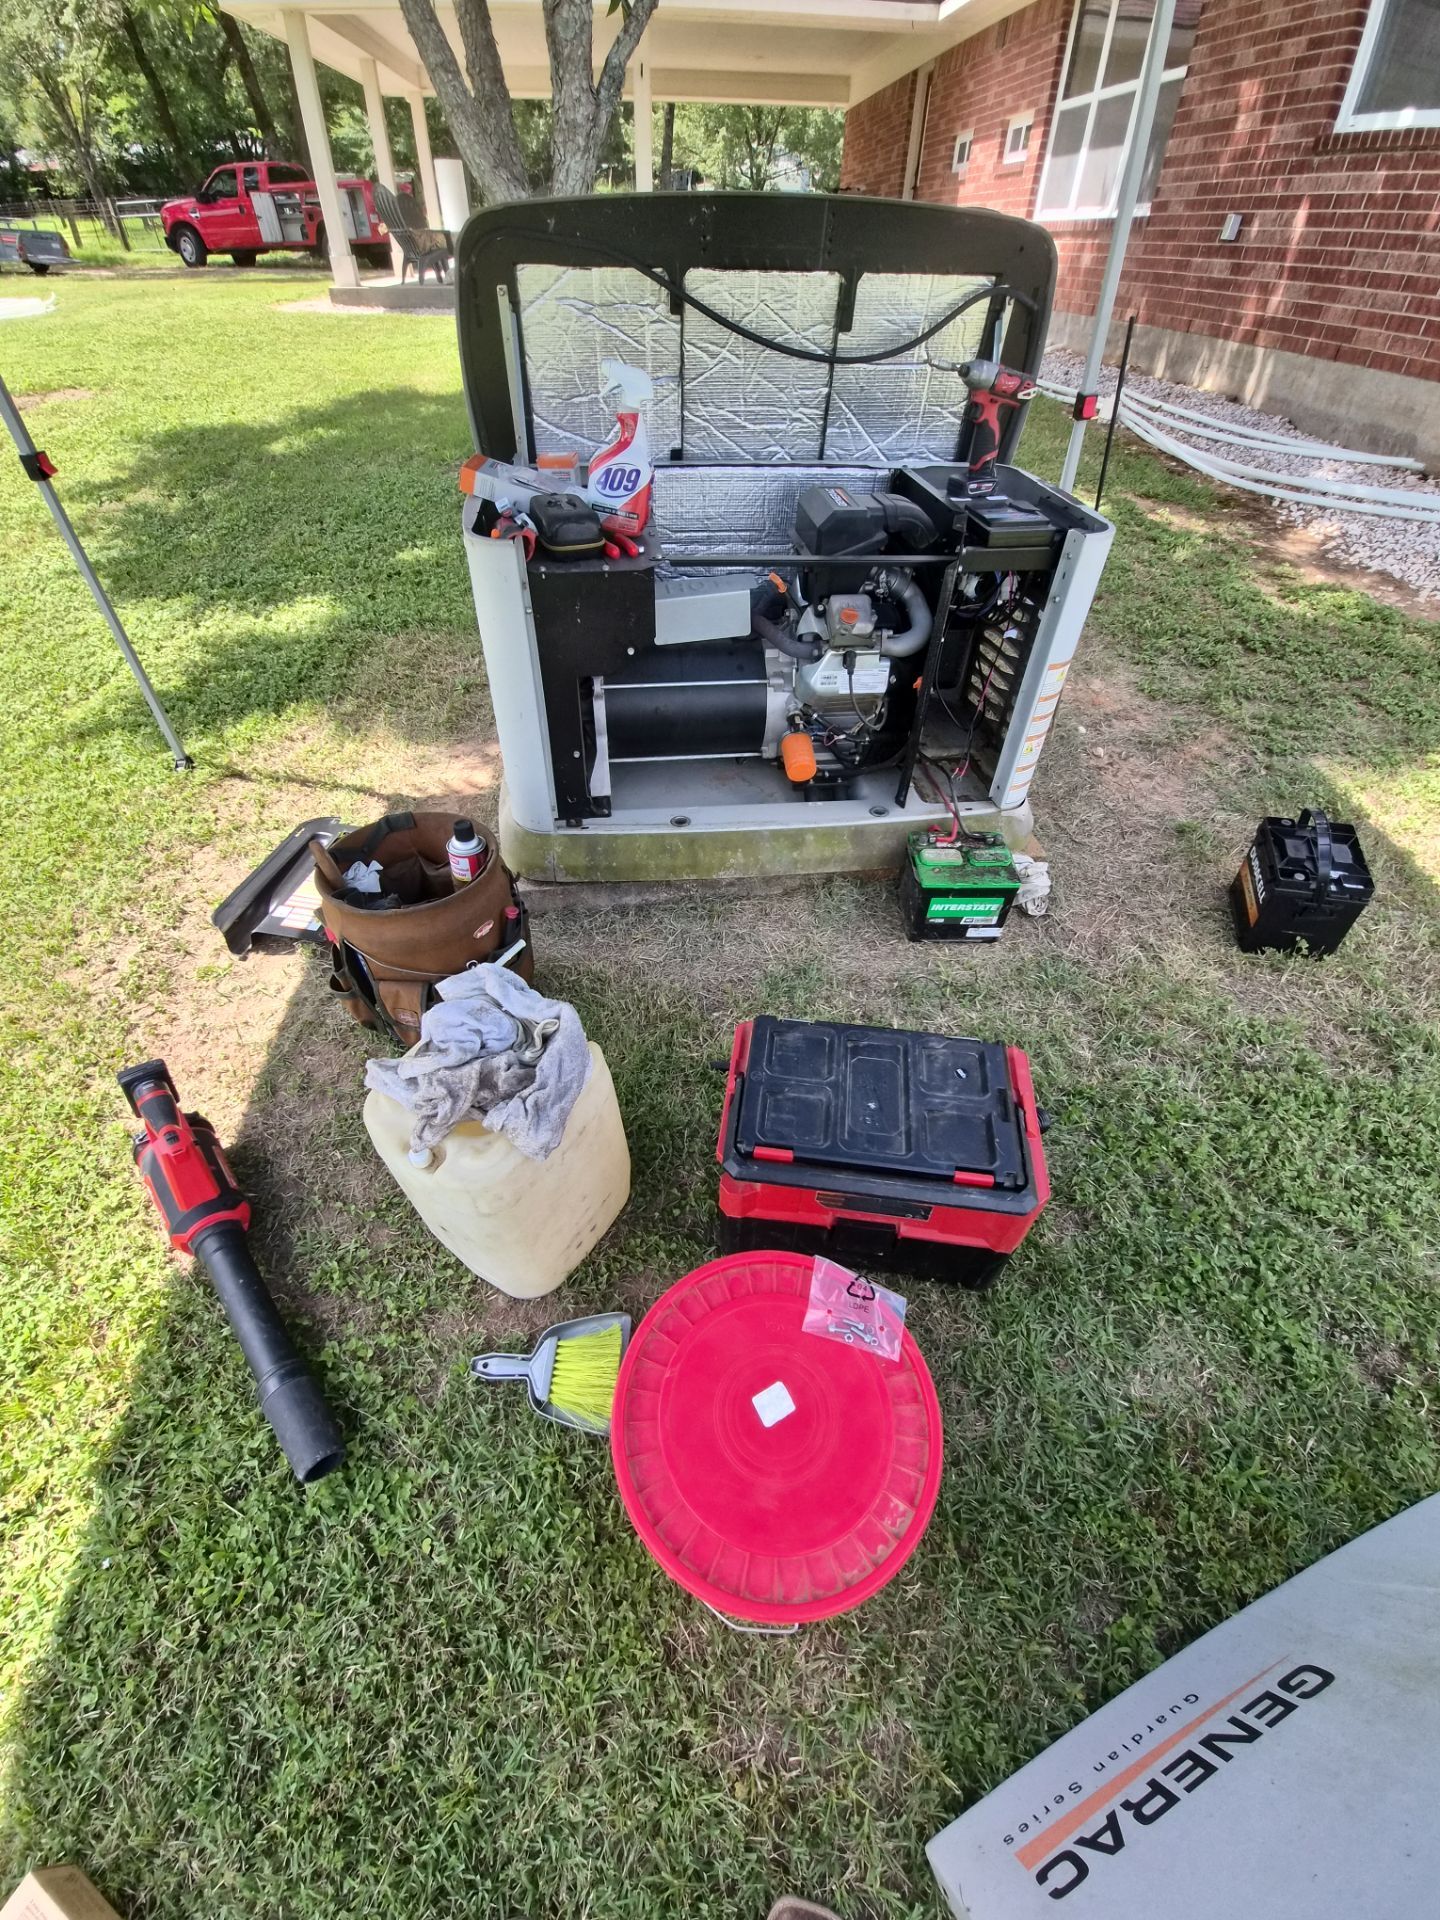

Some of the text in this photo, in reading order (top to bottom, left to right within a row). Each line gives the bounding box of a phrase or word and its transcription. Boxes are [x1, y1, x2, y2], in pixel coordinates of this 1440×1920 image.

[595, 467, 641, 493] 409
[930, 903, 999, 911] INTERSTATE
[848, 1302, 870, 1313] LDPE
[1003, 1693, 1200, 1846] Guardian Series
[1035, 1664, 1336, 1900] GENERAC
